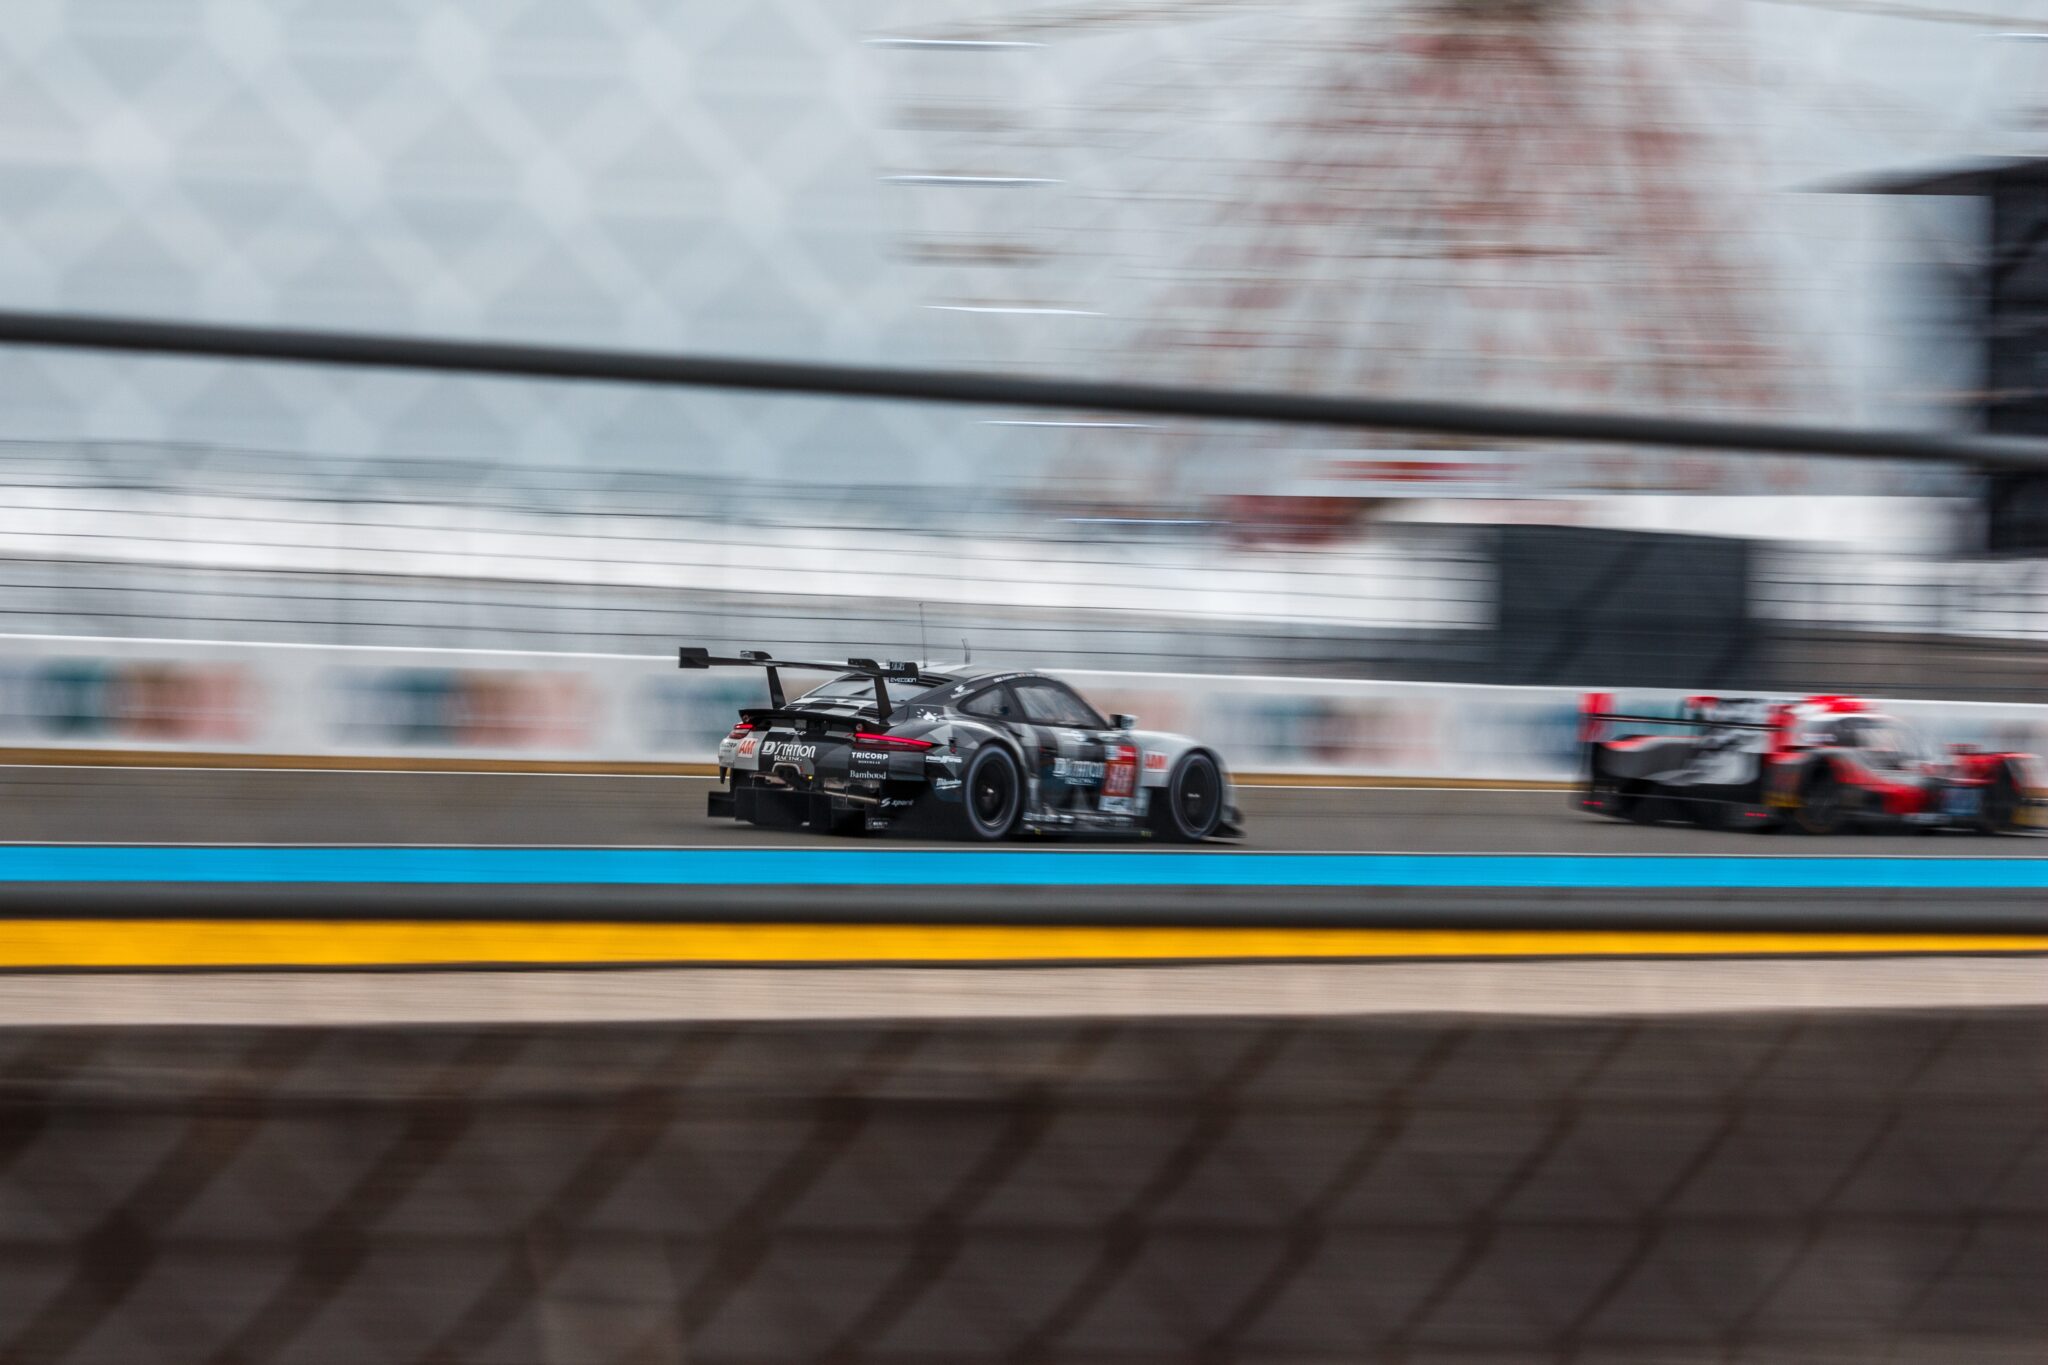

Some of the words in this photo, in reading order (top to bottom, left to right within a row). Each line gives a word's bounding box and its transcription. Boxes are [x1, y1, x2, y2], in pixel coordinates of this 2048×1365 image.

[738, 740, 756, 755] AM
[761, 741, 816, 758] D'STATION
[851, 752, 889, 760] TRICORP
